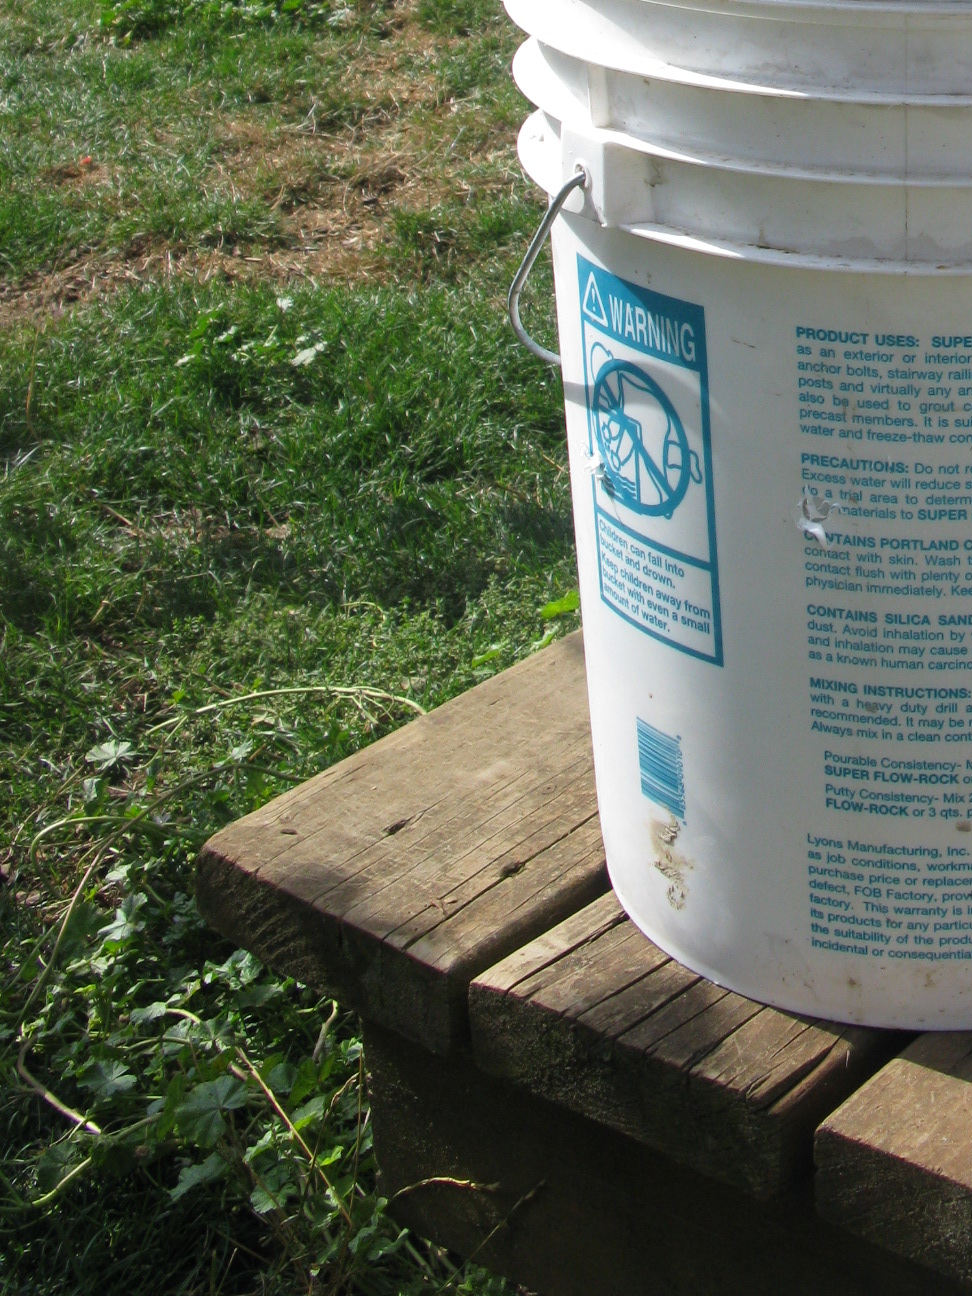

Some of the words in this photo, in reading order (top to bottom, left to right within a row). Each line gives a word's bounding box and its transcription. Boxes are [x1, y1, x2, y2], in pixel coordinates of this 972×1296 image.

[608, 293, 696, 362] WARNING
[795, 326, 870, 343] PRODUCT
[875, 334, 920, 346] USES:
[797, 361, 842, 374] anchor
[847, 365, 882, 379] bolts,
[888, 369, 943, 383] stairway
[798, 377, 833, 390] posts
[840, 382, 864, 393] and
[871, 384, 921, 398] virtually
[928, 388, 951, 399] any
[800, 425, 835, 437] water
[839, 429, 863, 440] and
[867, 431, 945, 444] freeze-thaw
[801, 453, 909, 473] PRECAUTIONS:
[914, 463, 933, 474] Do
[939, 464, 960, 474] not
[599, 519, 628, 549] Children
[630, 544, 646, 560] can
[648, 552, 662, 568] fall
[665, 559, 684, 577] into
[804, 531, 876, 547] CNTAINS
[880, 538, 959, 550] PORTLAND
[600, 533, 623, 560] bucket
[625, 555, 640, 571] and
[601, 550, 618, 574] Keep
[620, 568, 654, 596] children
[656, 589, 681, 610] away
[684, 600, 710, 619] from
[805, 577, 863, 592] physician
[867, 585, 946, 598] immediately.
[602, 566, 625, 590] bucket
[627, 586, 645, 605] with
[647, 599, 669, 617] even
[672, 611, 678, 621] a
[681, 615, 710, 634] small
[604, 583, 629, 609] amount
[631, 604, 639, 616] of
[641, 609, 671, 632] water.
[807, 604, 878, 622] CONTAINS
[885, 613, 931, 625] SILICA
[808, 651, 822, 661] as
[826, 654, 834, 663] a
[837, 654, 877, 667] known
[881, 658, 924, 670] human
[810, 677, 858, 693] MIXING
[864, 685, 972, 698] INSTRUCTIONS:
[824, 751, 877, 767] Pourable
[825, 765, 869, 780] SUPER
[874, 771, 959, 785] FLOW-ROCK
[812, 937, 868, 956] incidental
[872, 949, 885, 957] or
